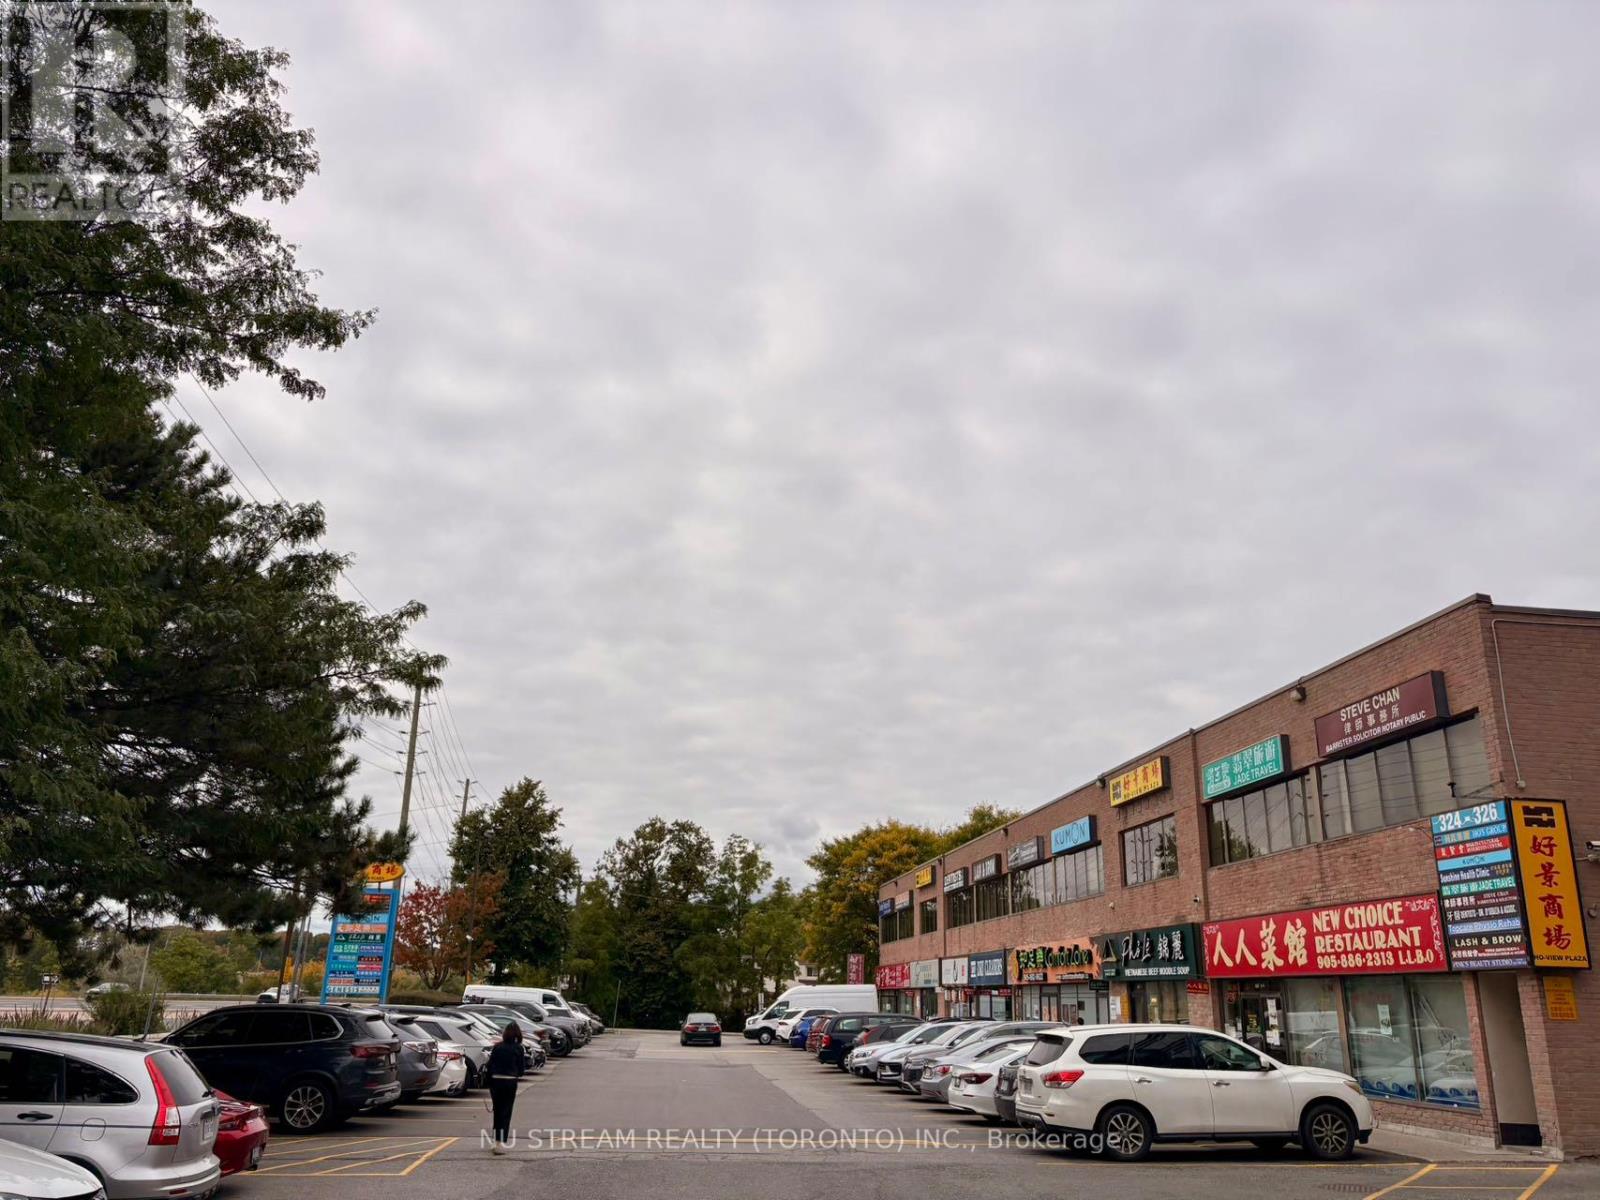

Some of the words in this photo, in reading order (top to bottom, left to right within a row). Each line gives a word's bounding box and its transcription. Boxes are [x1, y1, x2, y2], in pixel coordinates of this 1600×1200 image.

[1340, 700, 1371, 721] STEVE
[1372, 687, 1400, 710] CHAN
[1325, 736, 1353, 753] BARRISTER
[1353, 727, 1381, 744] SOLICITOR
[1381, 719, 1404, 735] NOTARY
[1404, 710, 1426, 725] PUBLIC
[1234, 772, 1251, 786] JADE
[1251, 761, 1279, 779] TRAVEL
[1438, 811, 1462, 832] 324
[1473, 803, 1498, 825] 326
[1054, 821, 1088, 845] KUMON
[1493, 876, 1516, 889] TRAVEL
[1529, 834, 1572, 951] 好景商場
[1312, 908, 1343, 933] NEW
[1344, 901, 1404, 930] CHOICE
[1213, 917, 1308, 971] 人人菜館
[1314, 926, 1422, 954] RESTAURANT
[1455, 937, 1478, 947] LASH
[1481, 937, 1488, 945] &
[1492, 934, 1522, 944] BROW
[1125, 967, 1148, 976] VIETNAMESE
[1148, 967, 1158, 976] BEEF
[1159, 967, 1177, 975] NOODLE
[1177, 966, 1190, 975] SOUP
